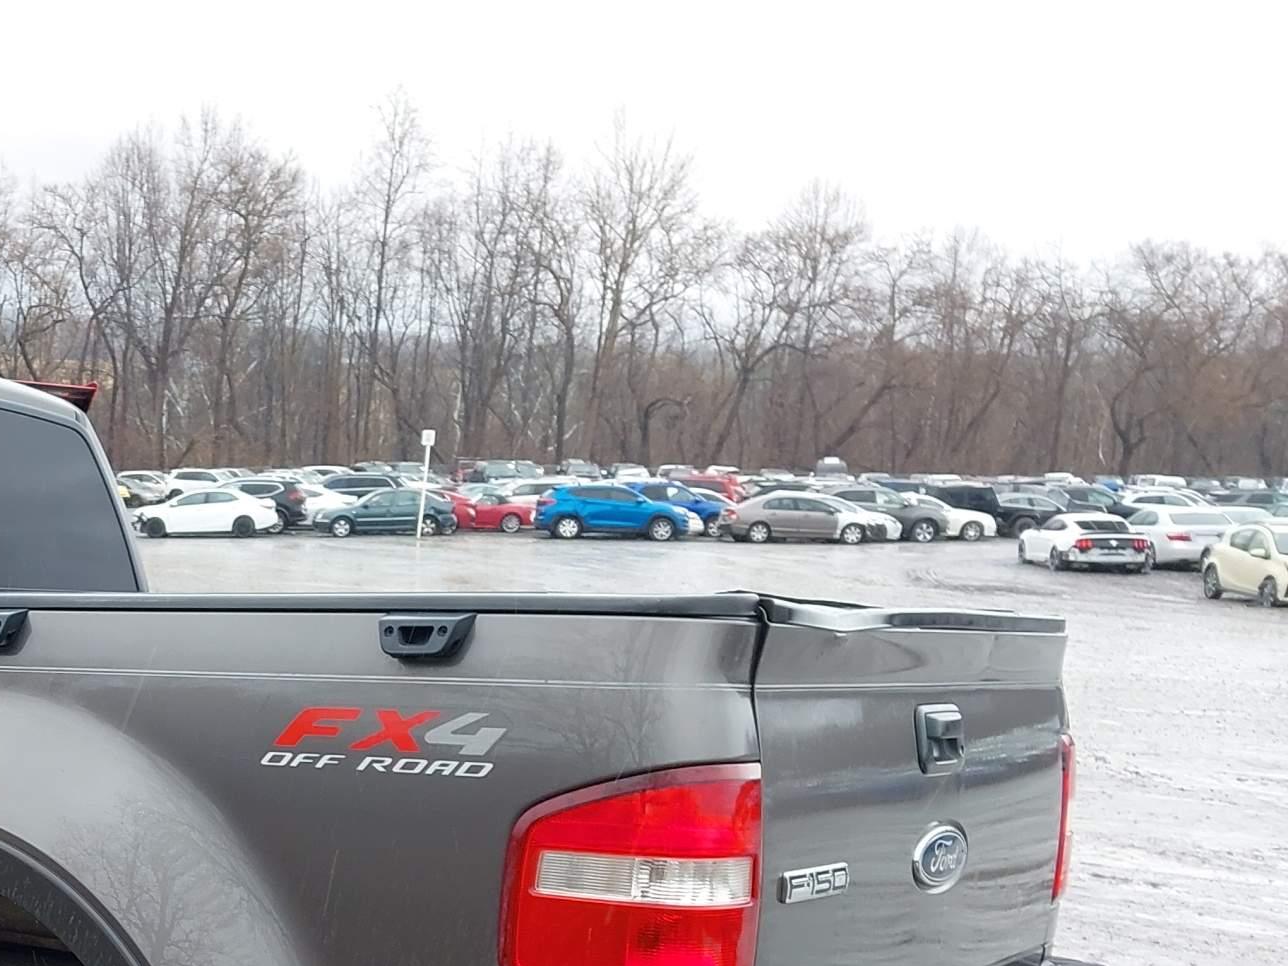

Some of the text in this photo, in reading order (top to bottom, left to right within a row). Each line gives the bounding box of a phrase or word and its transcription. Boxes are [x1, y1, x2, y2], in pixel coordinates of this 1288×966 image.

[273, 706, 508, 757] FX4
[261, 751, 494, 778] OFF ROAD
[930, 839, 960, 872] Ford
